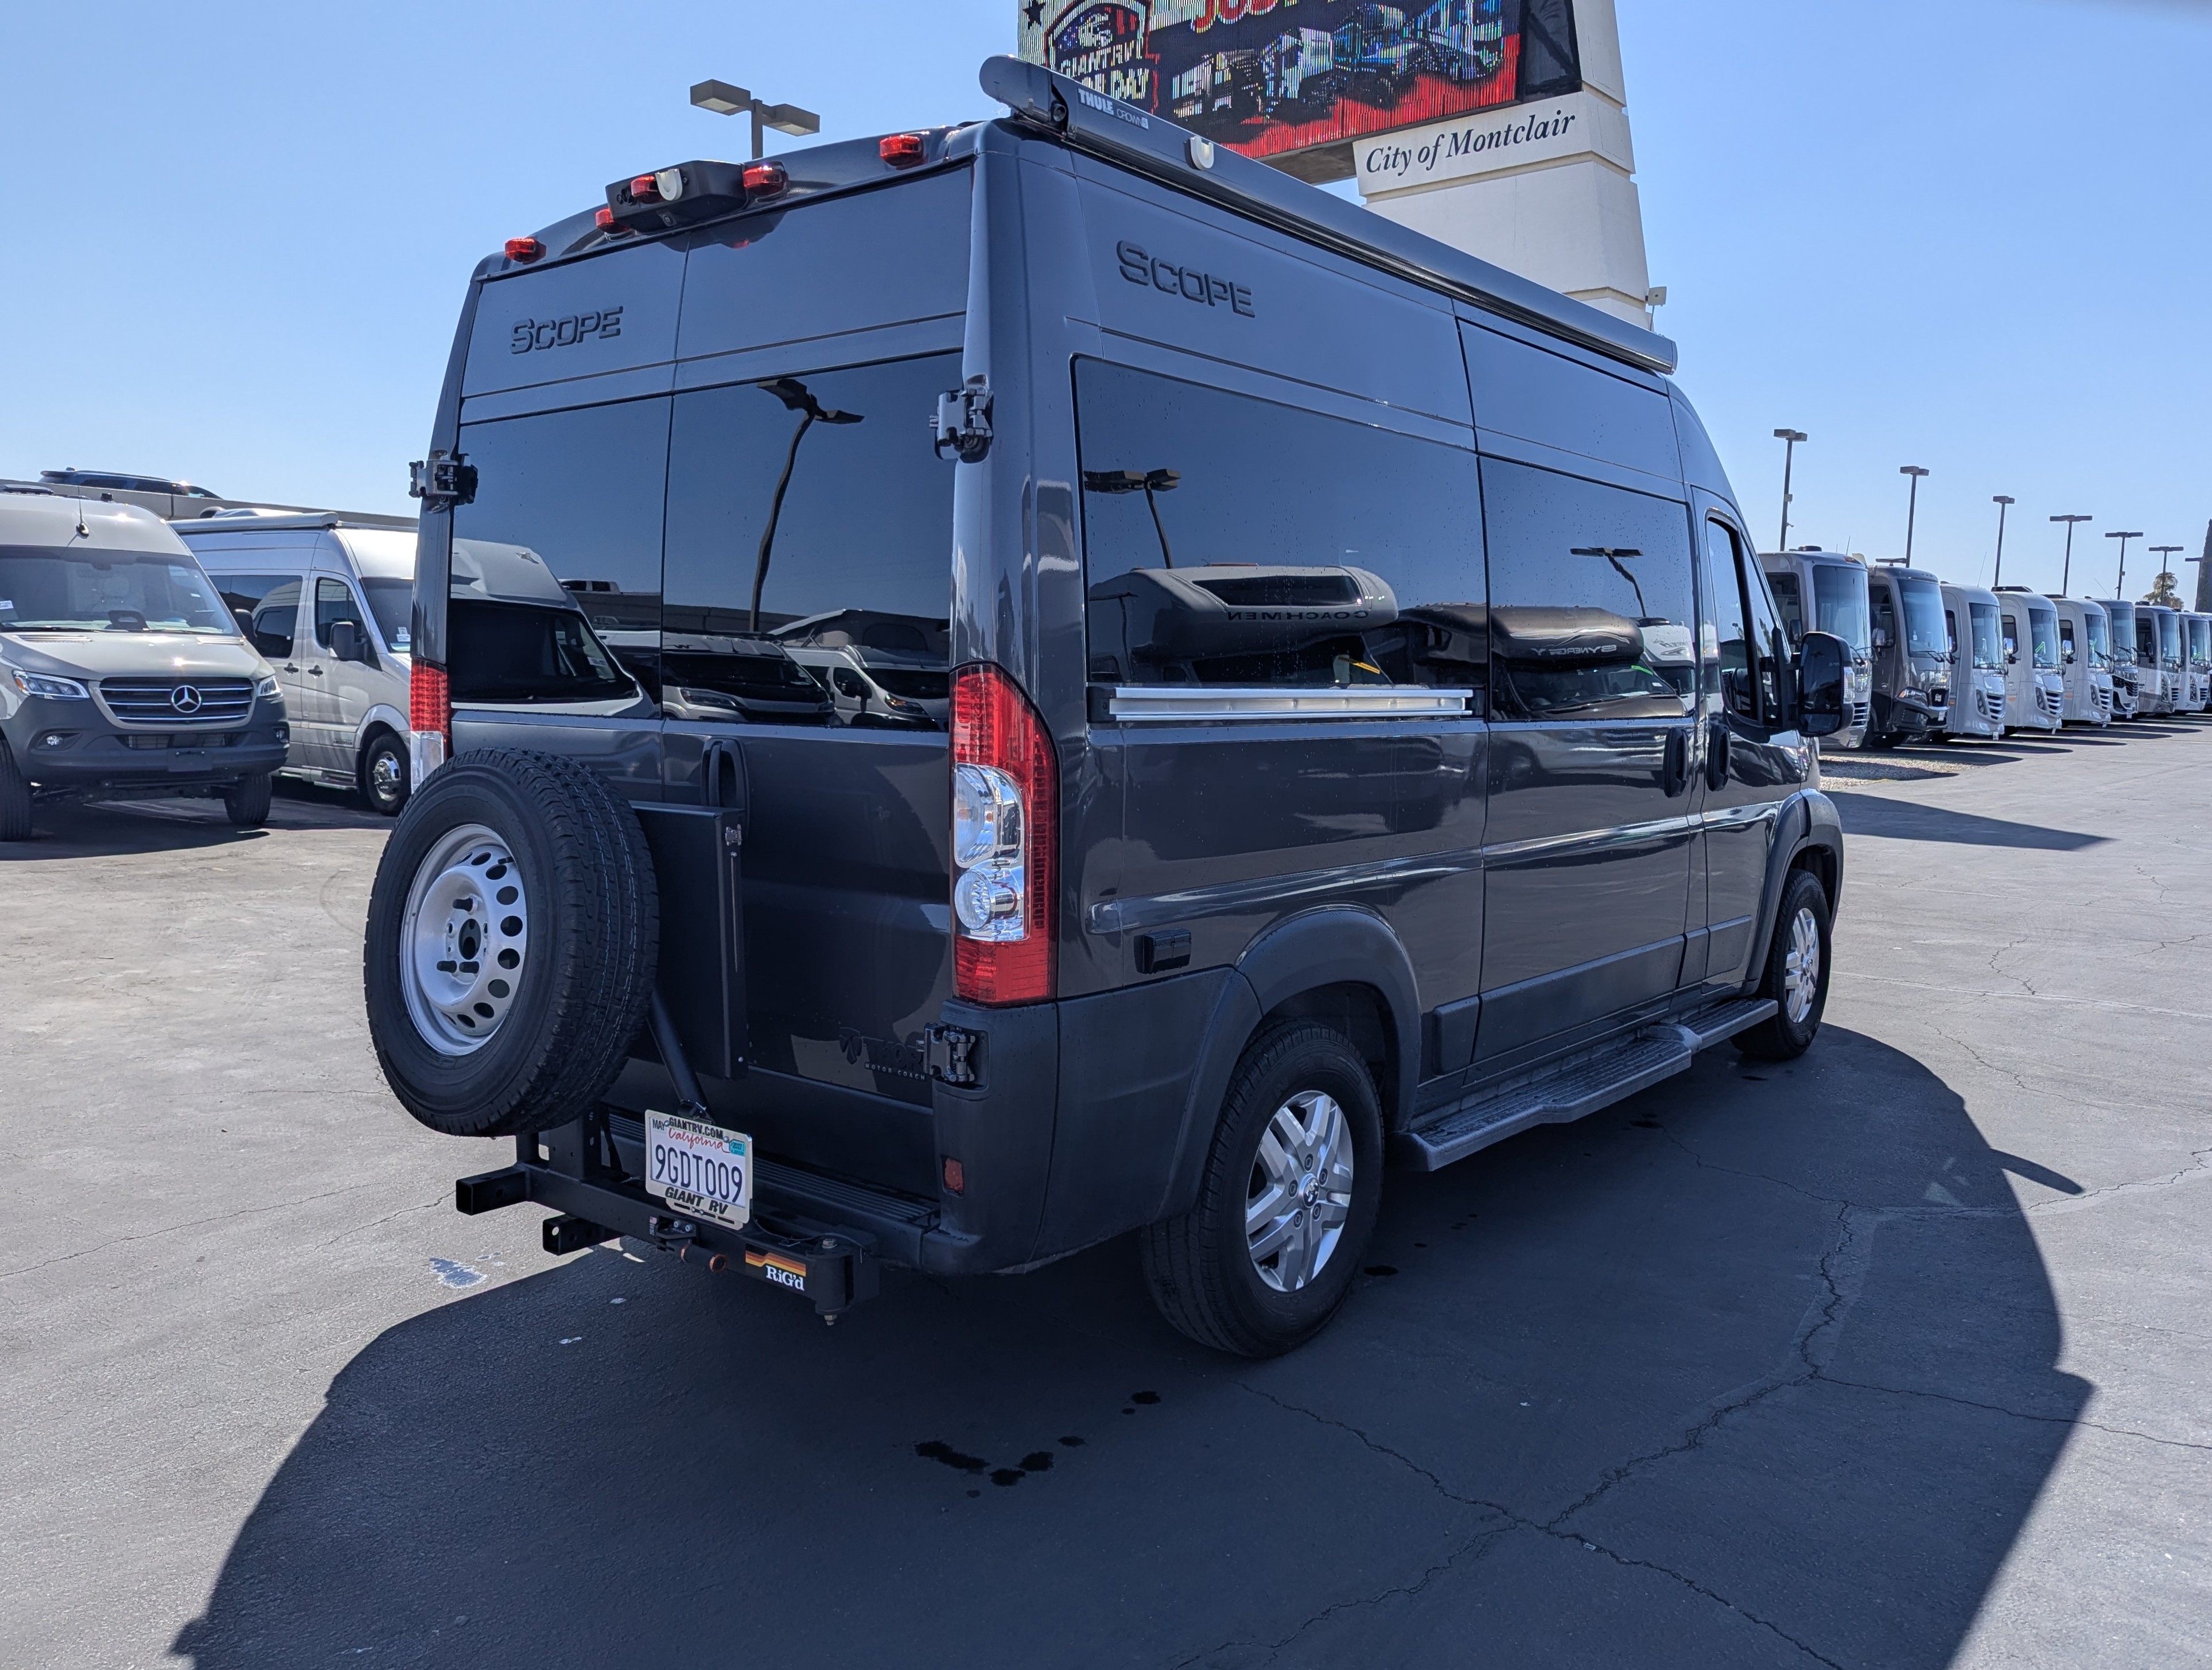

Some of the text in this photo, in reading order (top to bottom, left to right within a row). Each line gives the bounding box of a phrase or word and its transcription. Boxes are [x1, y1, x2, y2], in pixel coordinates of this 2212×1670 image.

[1078, 88, 1114, 115] THULE
[1366, 109, 1576, 176] City of Montclair
[1116, 240, 1255, 319] SCOPE
[510, 305, 624, 355] SCOPE
[865, 1063, 926, 1081] MOTOR COACH
[652, 1119, 665, 1131] MAY
[668, 1117, 724, 1140] GIANTRV.COM
[668, 1128, 731, 1154] California
[655, 1144, 742, 1203] 9GDT009
[664, 1186, 729, 1215] GIANT RV
[765, 1265, 805, 1291] RiG'd
